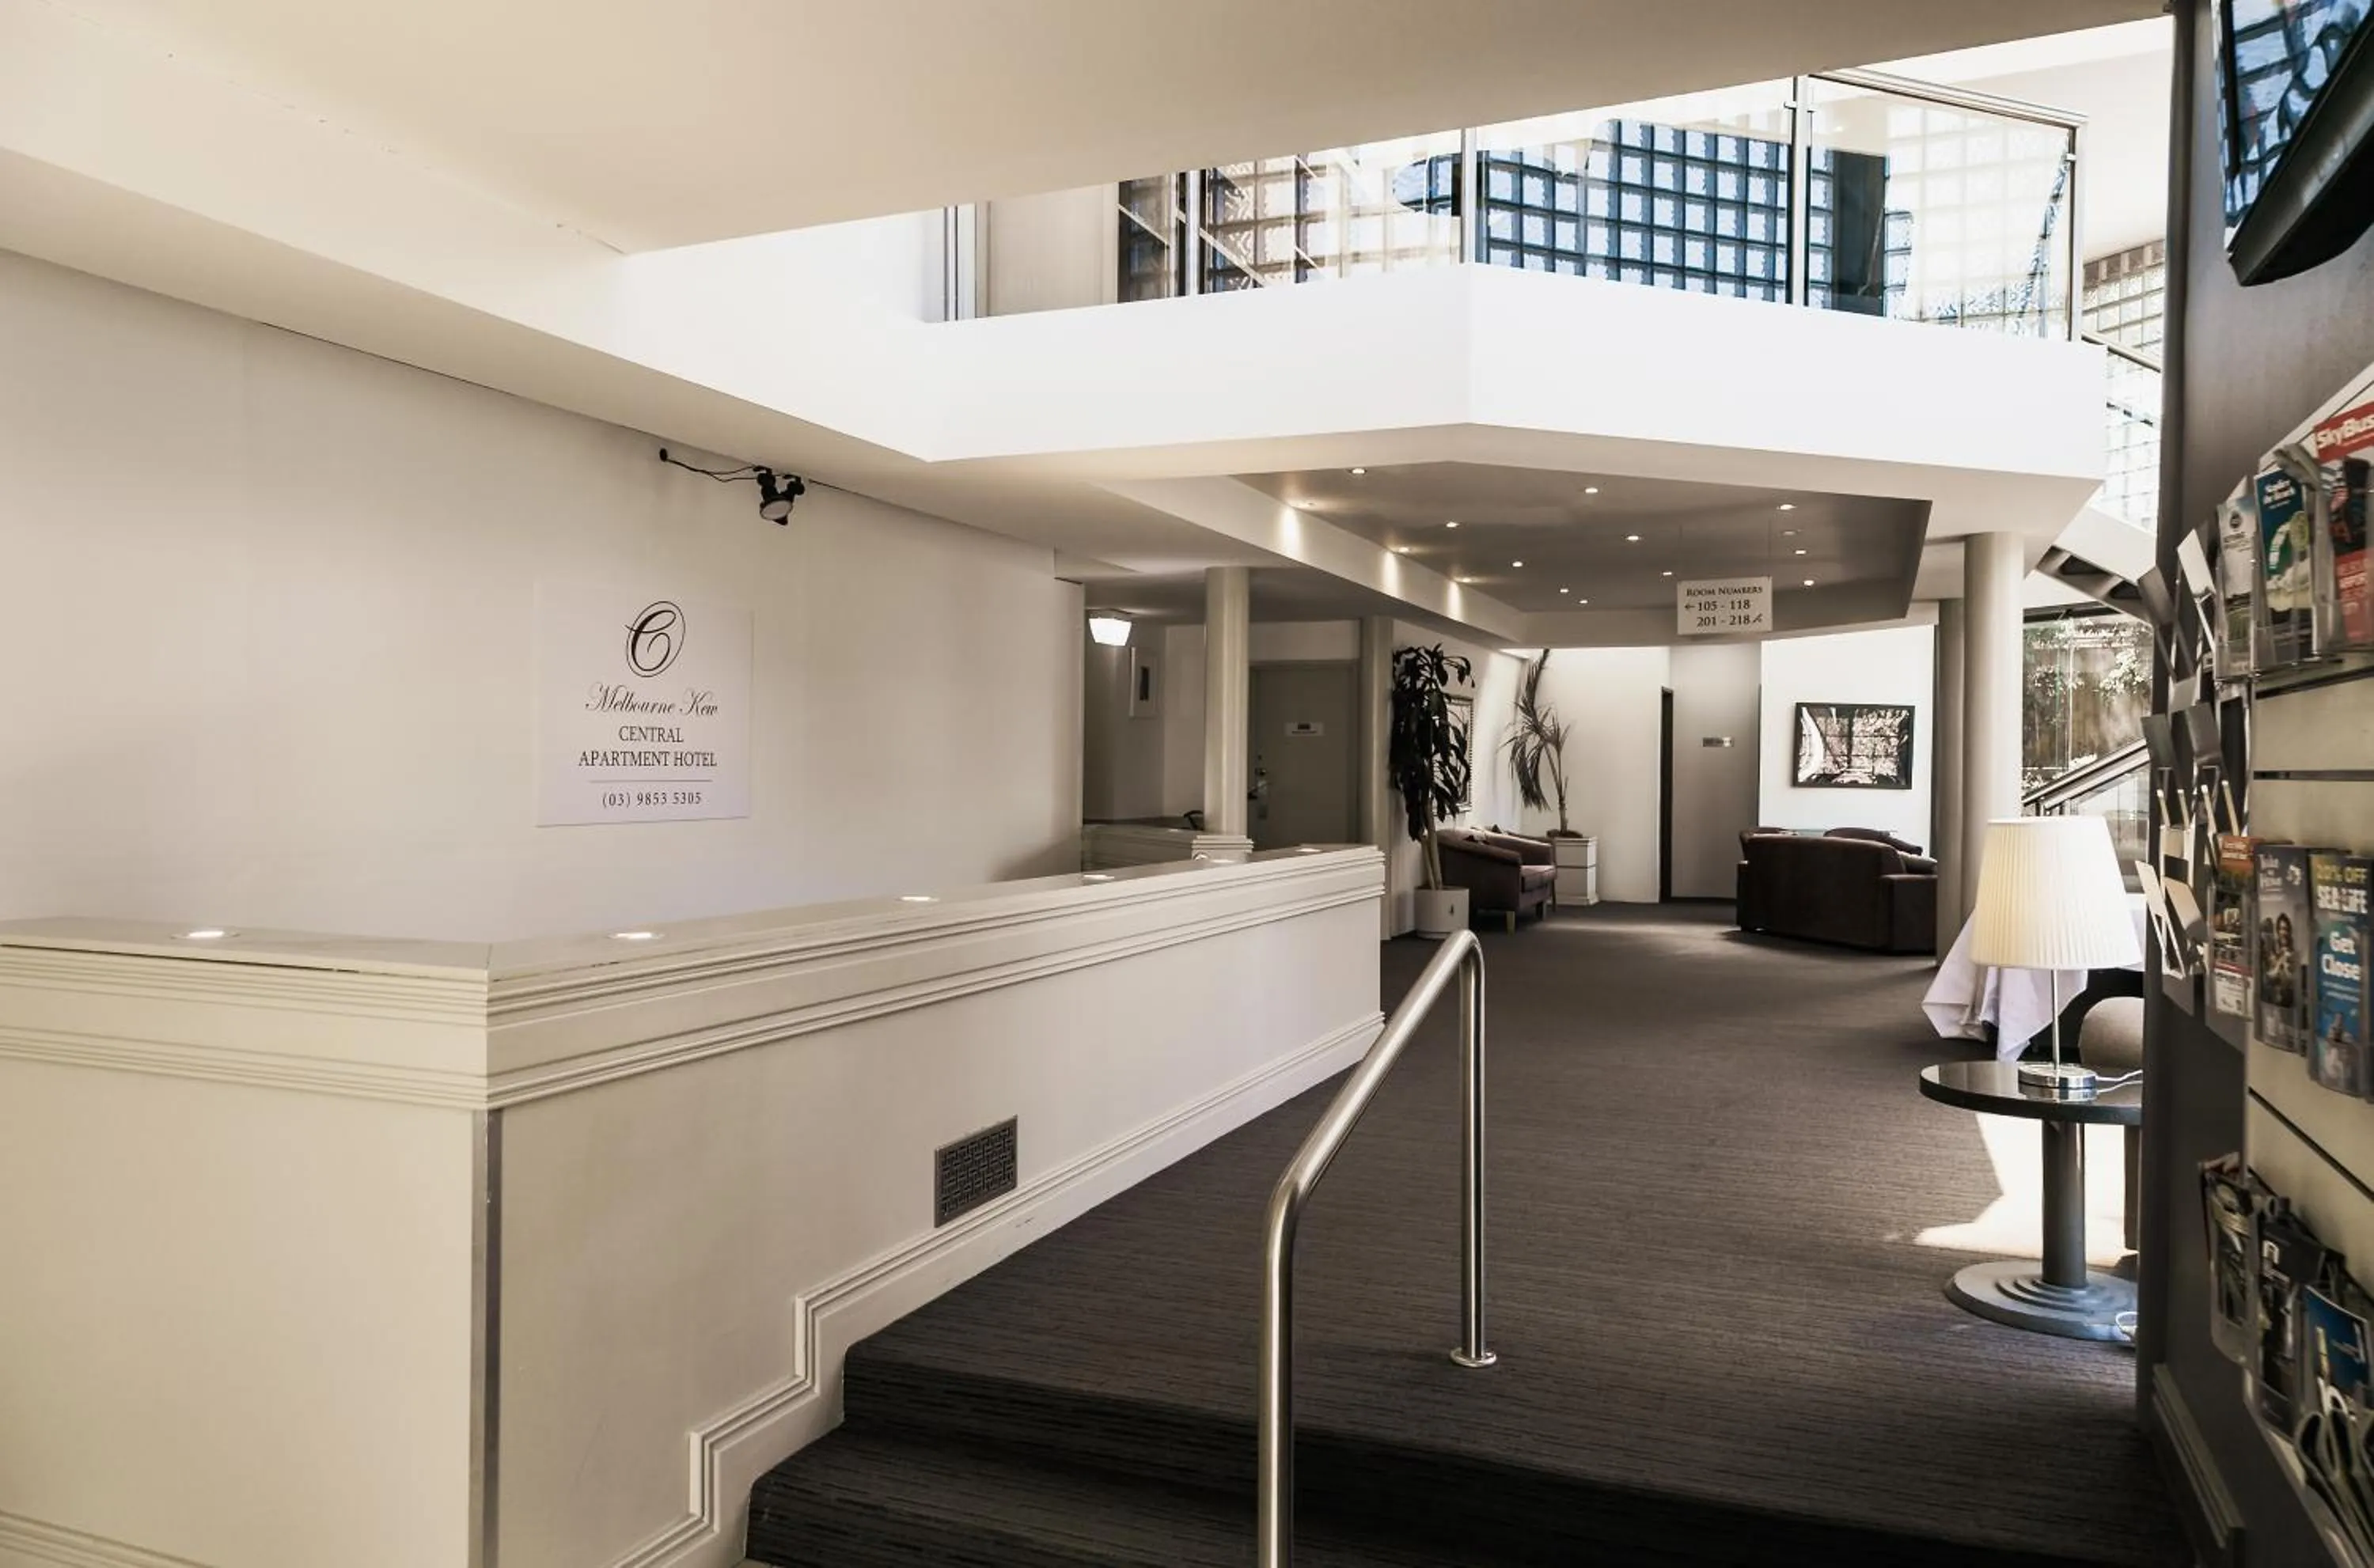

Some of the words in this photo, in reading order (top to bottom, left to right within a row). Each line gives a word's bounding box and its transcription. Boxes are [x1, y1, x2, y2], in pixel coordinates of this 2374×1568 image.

[2316, 413, 2374, 449] SkyBus
[1686, 588, 1716, 597] ROOM
[1719, 586, 1763, 596] NUMBERS
[1697, 601, 1717, 611] 105
[1730, 600, 1750, 610] 118
[1697, 616, 1716, 627] 201
[1729, 615, 1750, 625] 218
[586, 682, 674, 714] Melbourne
[679, 687, 718, 716] Kew
[618, 725, 684, 743] CENTRAL
[578, 751, 669, 767] APARTMENT
[673, 752, 717, 767] HOTEL
[602, 793, 631, 808] (03)
[636, 792, 667, 805] 9853
[673, 792, 701, 804] 5305
